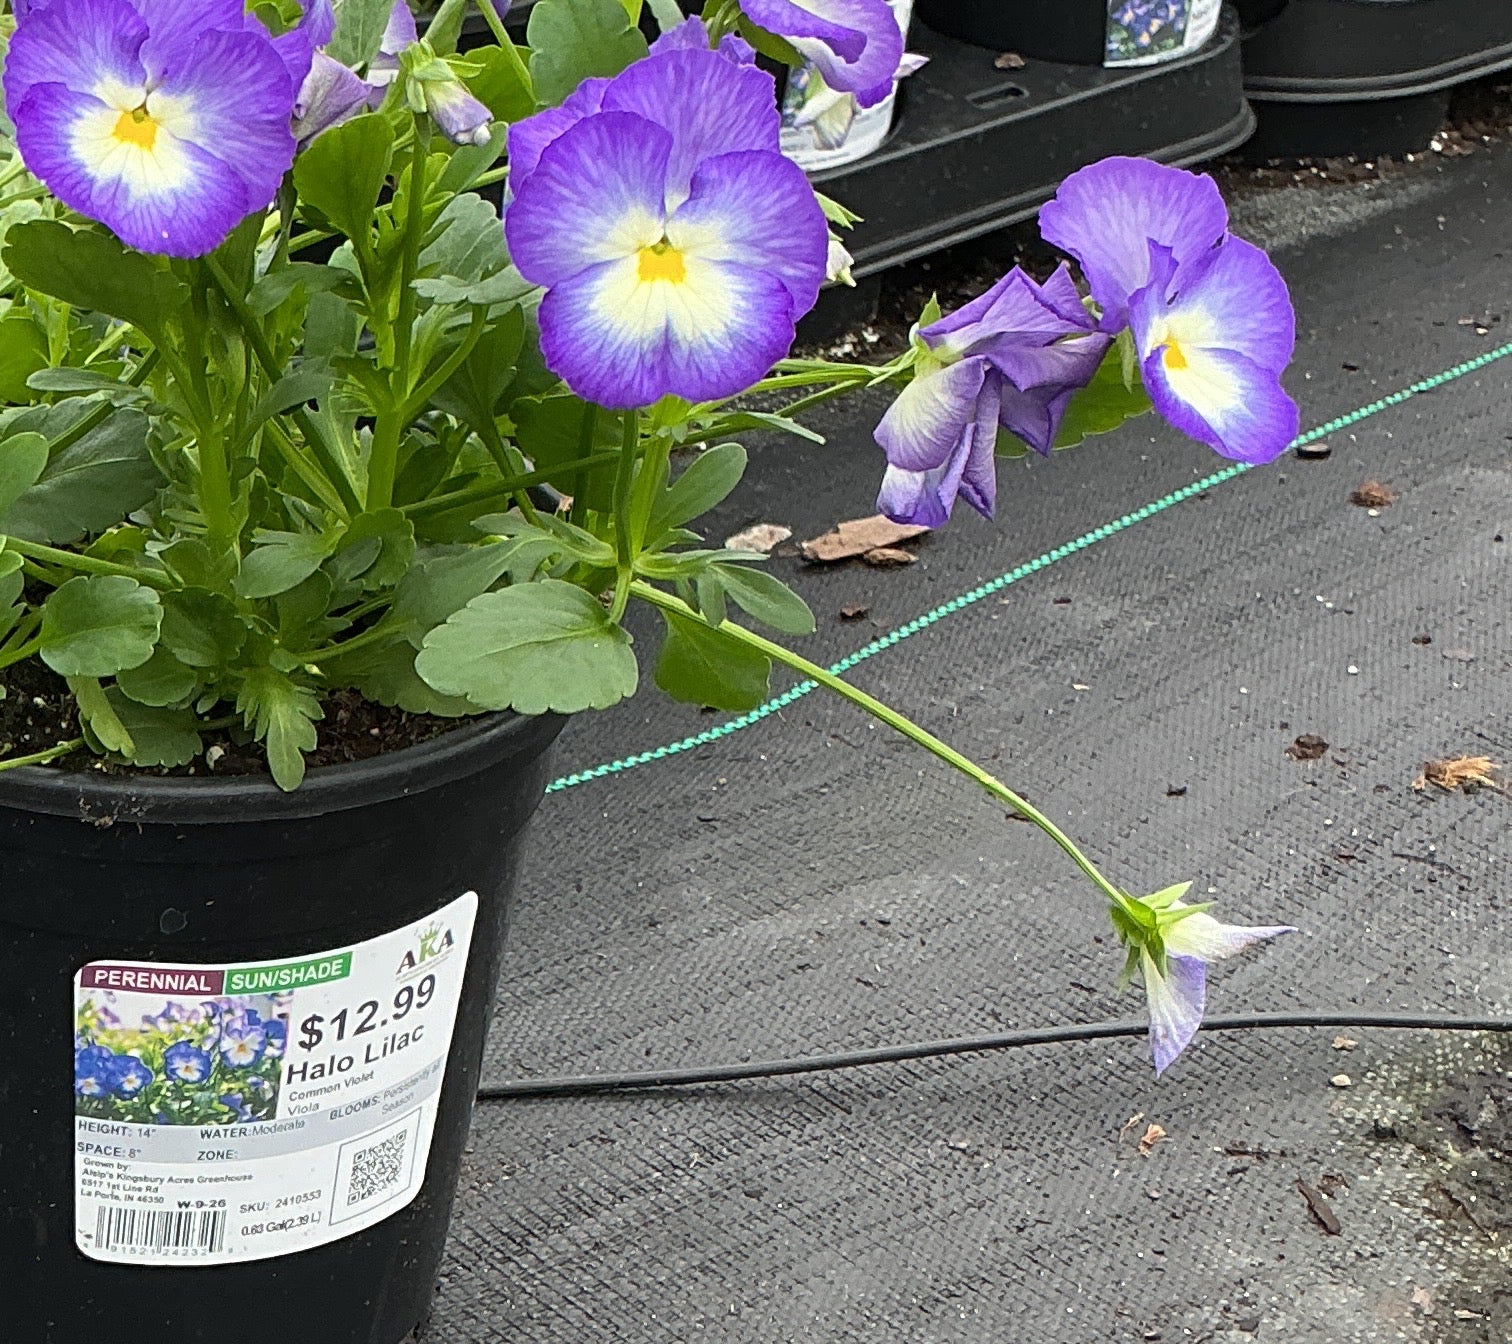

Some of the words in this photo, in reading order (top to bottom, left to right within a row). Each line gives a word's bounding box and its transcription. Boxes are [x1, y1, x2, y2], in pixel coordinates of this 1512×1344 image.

[395, 927, 455, 976] AKA
[93, 969, 212, 992] PERENNIAL
[230, 958, 344, 991] SUN/SHADE
[297, 973, 437, 1051] $12.99
[286, 1053, 354, 1085] Halo
[363, 1024, 425, 1066] Lilac
[288, 1083, 341, 1102] Common
[344, 1070, 375, 1088] Violet
[287, 1102, 320, 1117] Viola
[329, 1094, 381, 1121] BLOOMS:
[77, 1120, 133, 1138] HEIGHT:
[76, 1141, 126, 1158] SPACE:
[197, 1149, 239, 1162] ZONE:
[83, 1157, 115, 1170] Grown
[116, 1171, 165, 1185] Kingsbury
[167, 1175, 195, 1184] Acres
[80, 1188, 93, 1198] La
[124, 1193, 135, 1203] IN
[145, 1185, 159, 1194] Rd
[177, 1199, 227, 1209] W-9-26
[239, 1201, 270, 1214] SKU:
[274, 1189, 323, 1209] 2410553
